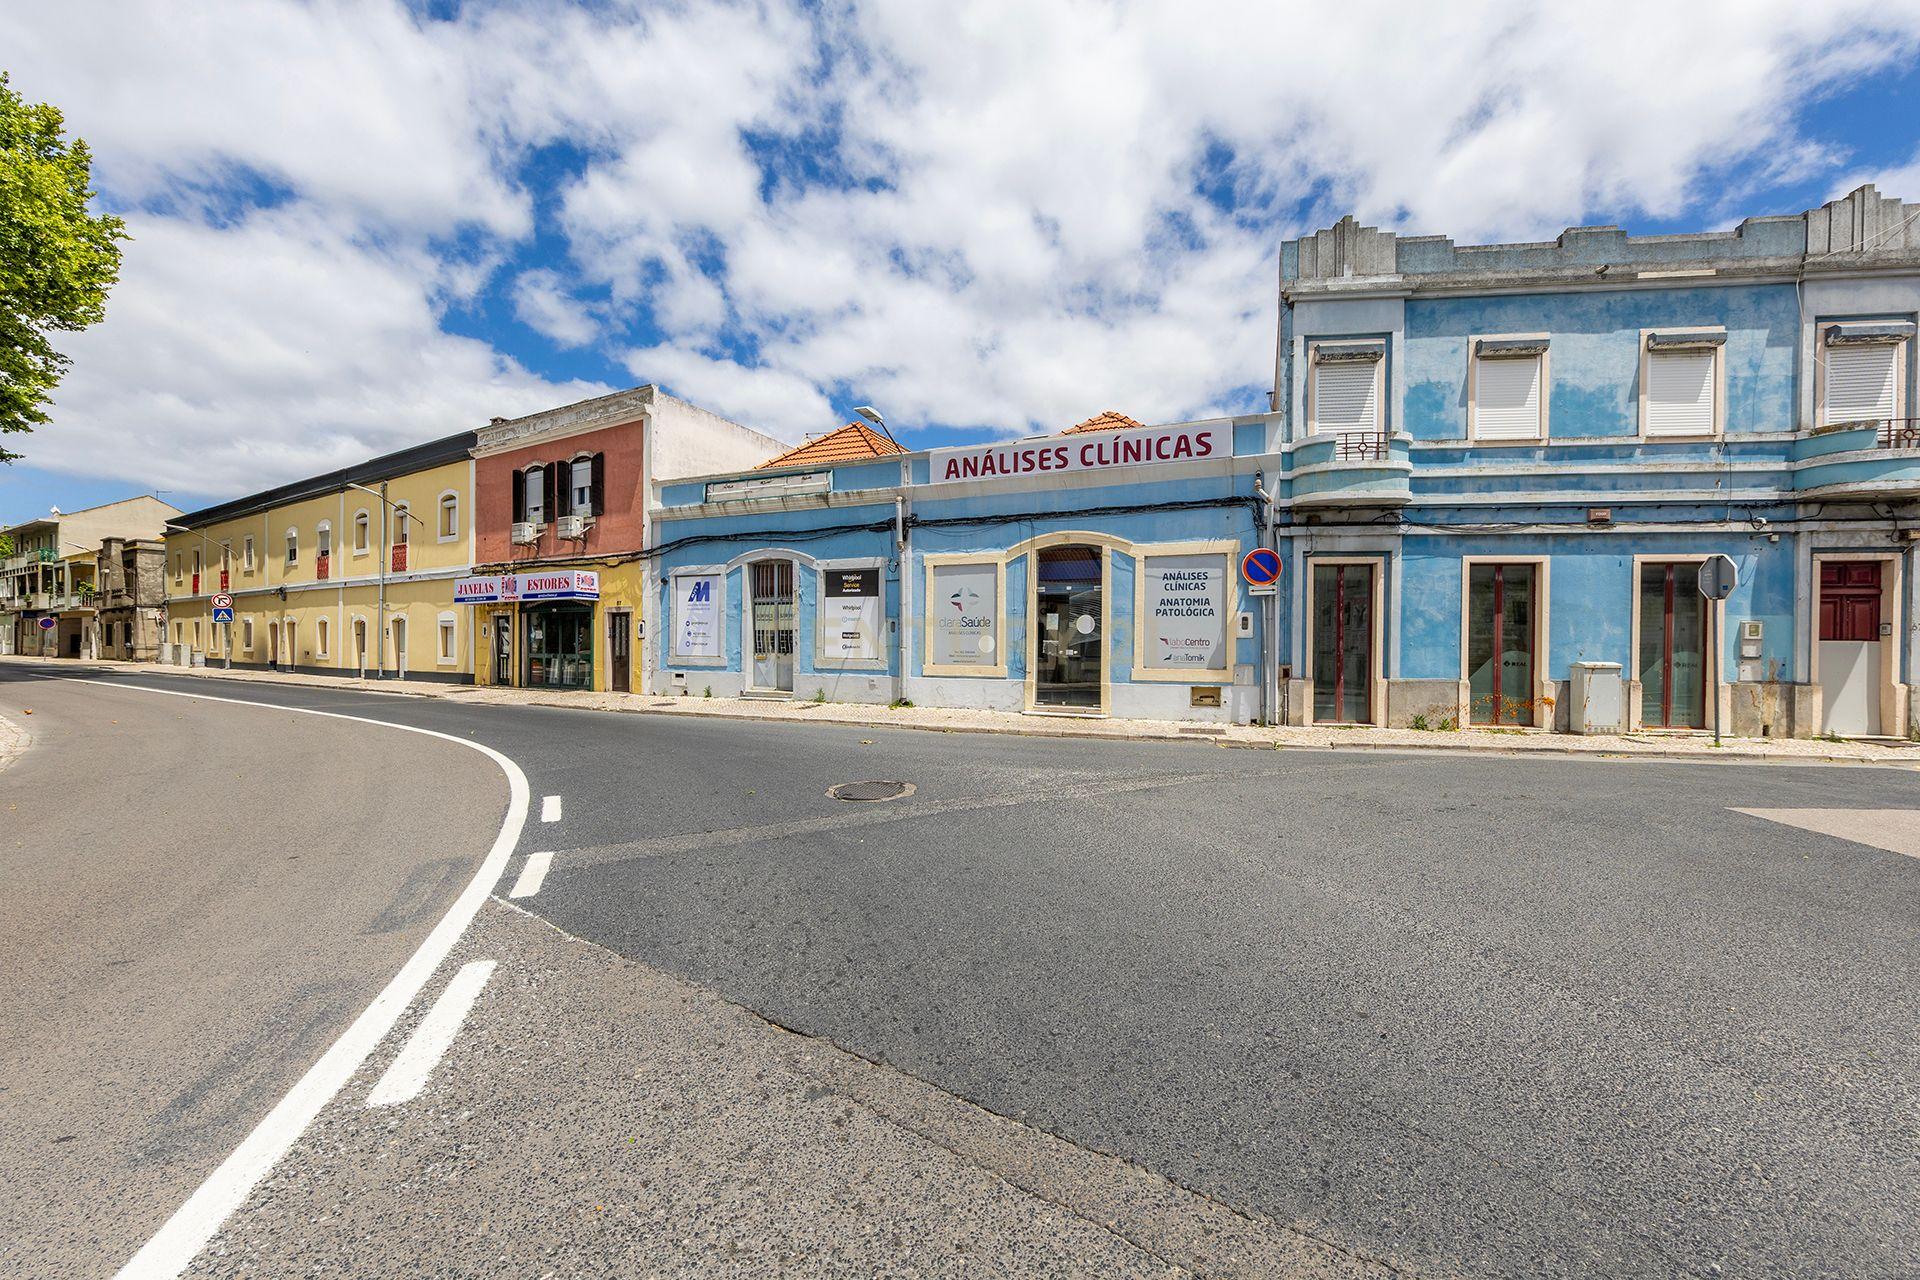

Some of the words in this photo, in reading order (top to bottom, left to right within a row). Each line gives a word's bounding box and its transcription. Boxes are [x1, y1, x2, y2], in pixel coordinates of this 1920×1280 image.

[945, 446, 1069, 480] ANÁLISES
[1080, 431, 1213, 467] CLÍNICAS
[1162, 571, 1208, 581] ANÁLISES
[457, 582, 494, 595] JANELAS
[527, 577, 570, 591] ESTORES
[1164, 582, 1206, 591] CLÍNICAS
[1159, 598, 1211, 606] ANATOMIA
[1155, 607, 1215, 617] PATOLÓGICA
